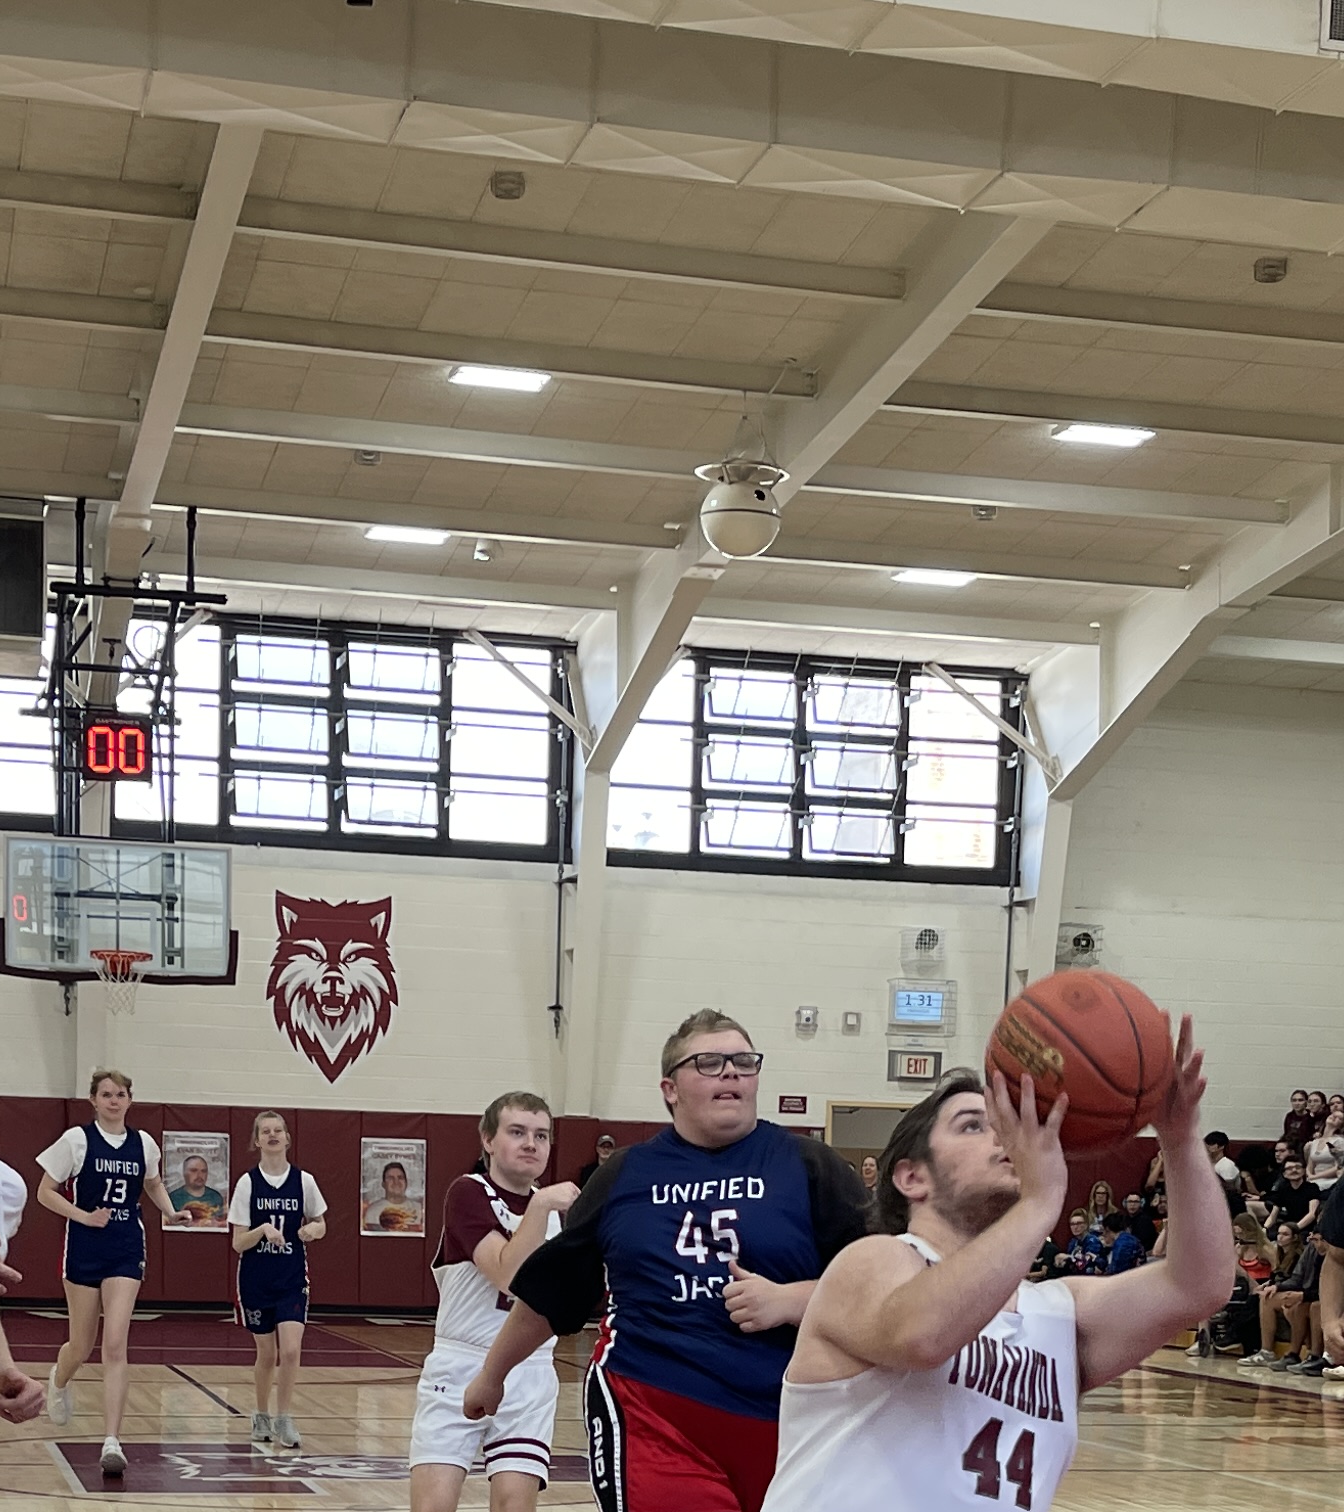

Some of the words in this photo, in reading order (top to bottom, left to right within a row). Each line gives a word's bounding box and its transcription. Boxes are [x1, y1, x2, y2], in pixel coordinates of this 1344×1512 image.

[87, 726, 145, 774] 00
[907, 1057, 929, 1075] EXIT
[95, 1158, 139, 1176] UNIFIED
[103, 1178, 127, 1204] 13
[652, 1176, 765, 1204] UNIFIED
[257, 1198, 298, 1211] UNIFIED
[269, 1214, 285, 1235] 11
[676, 1208, 740, 1264] 45
[671, 1274, 735, 1302] JAC
[962, 1417, 1036, 1512] 44
